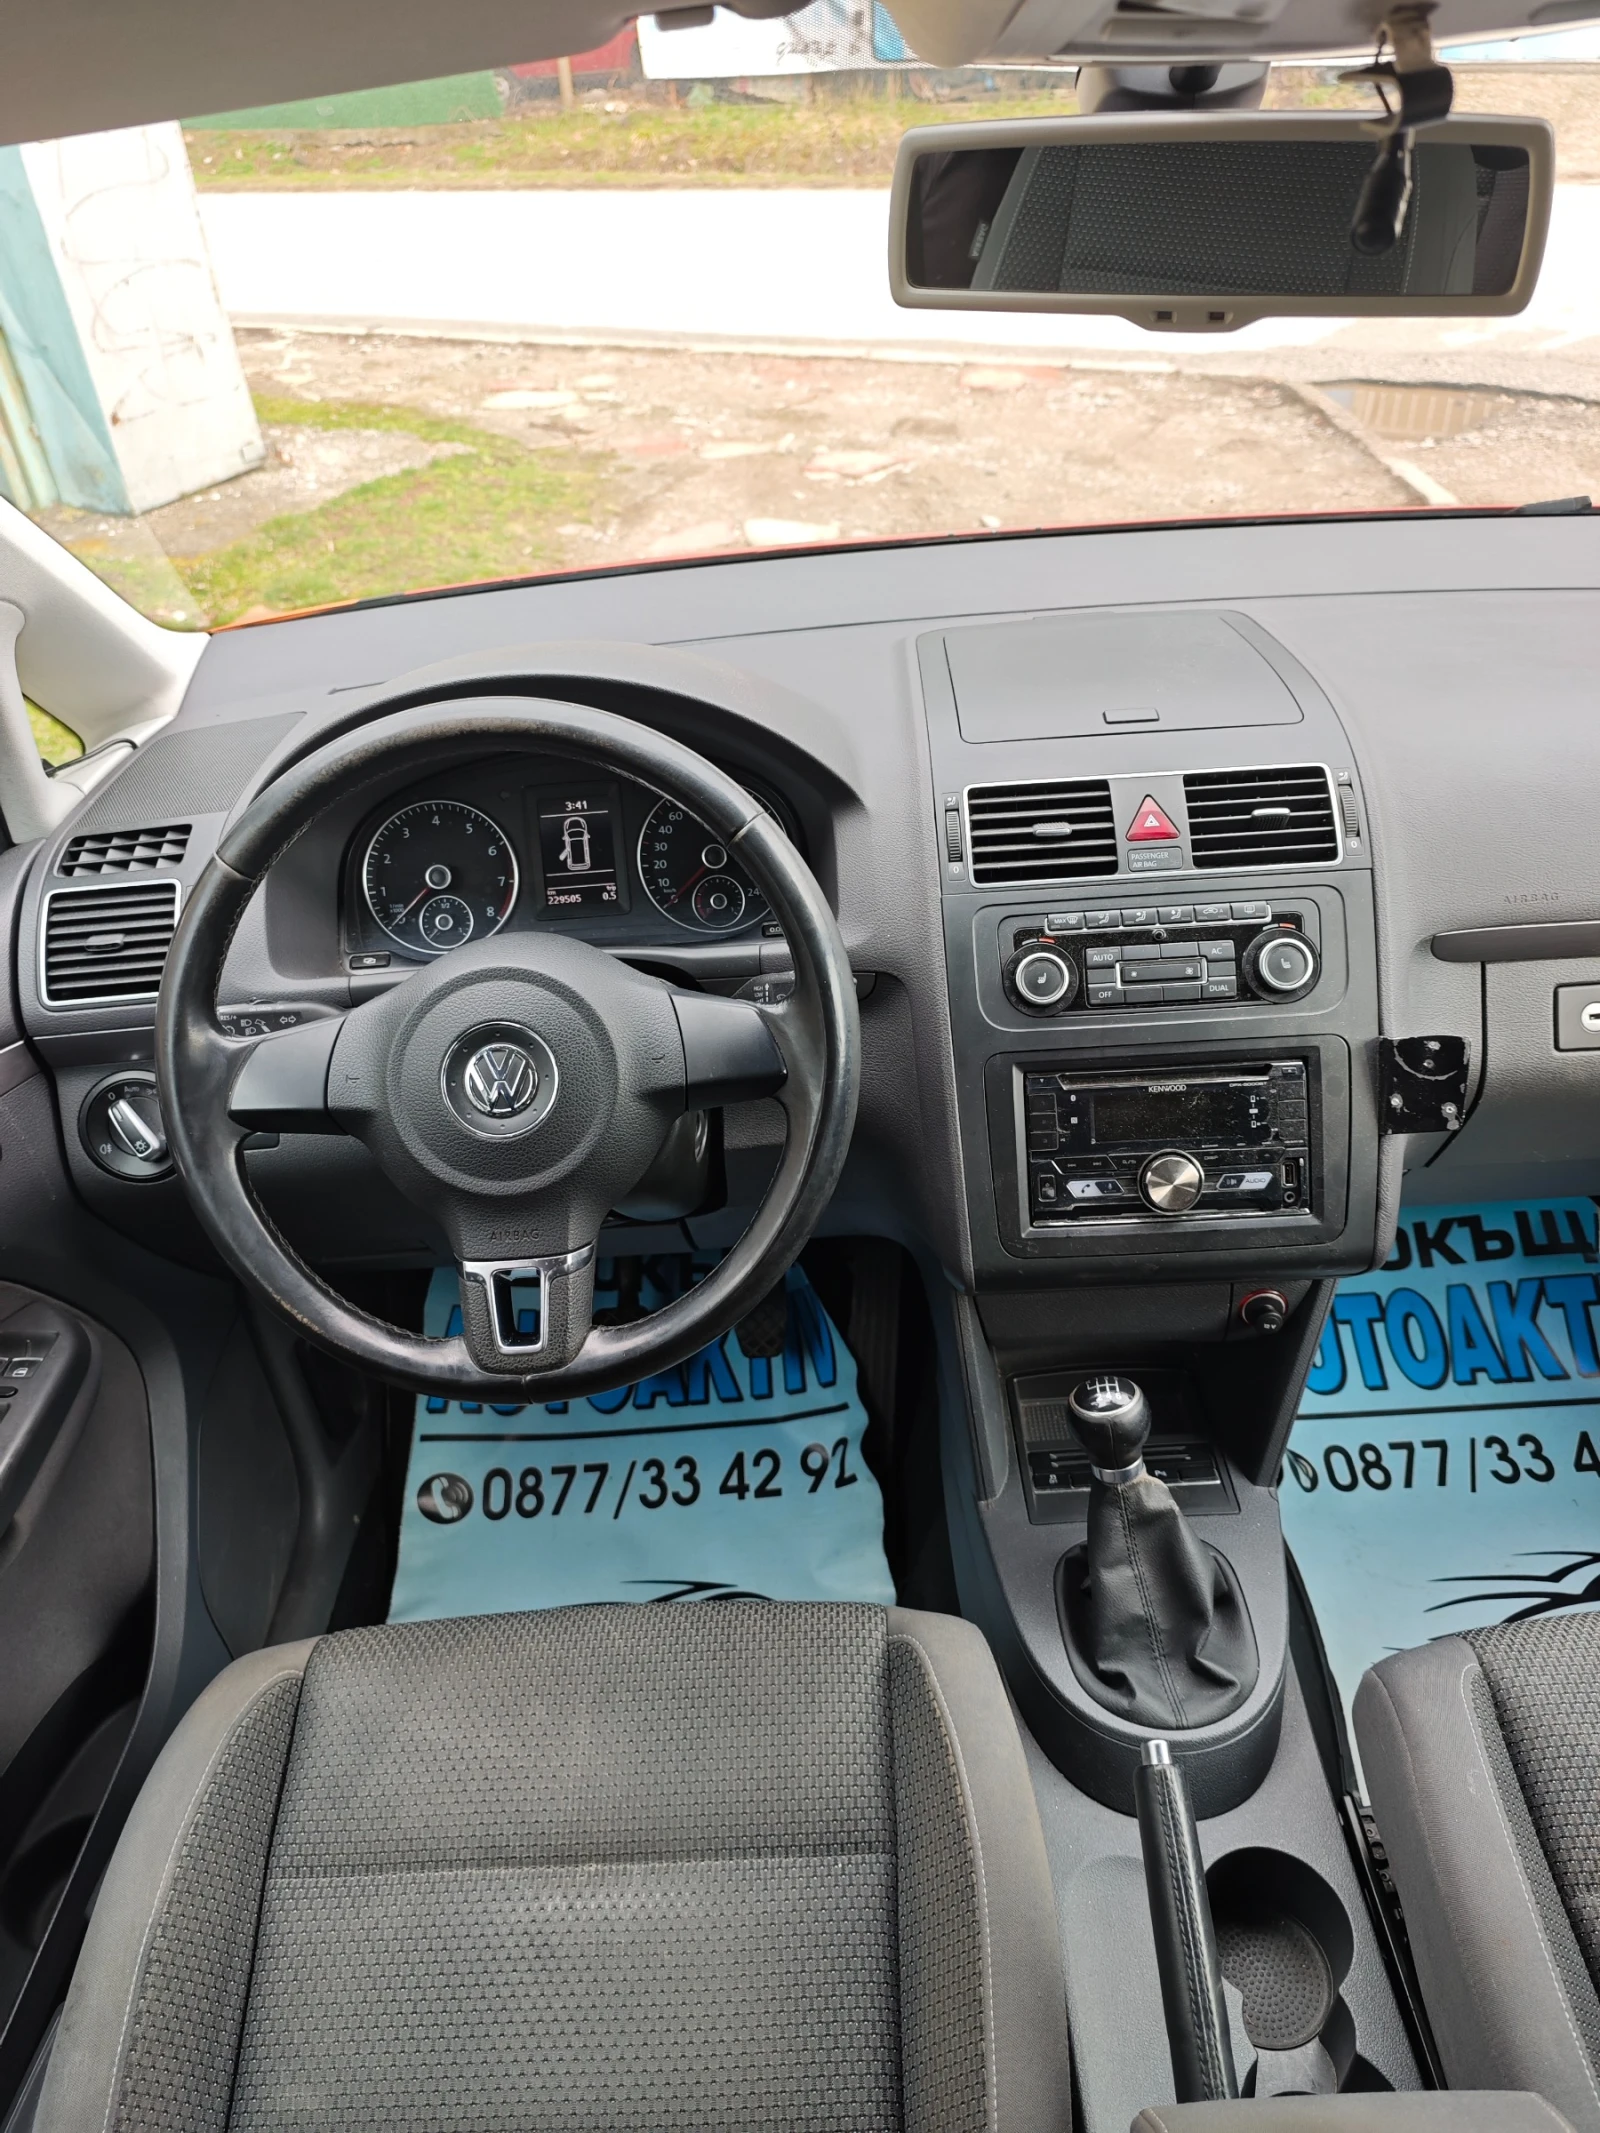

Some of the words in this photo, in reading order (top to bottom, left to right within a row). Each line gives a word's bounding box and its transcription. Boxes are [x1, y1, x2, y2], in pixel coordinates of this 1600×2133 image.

[565, 800, 588, 811] 3:41
[431, 815, 440, 826] 4
[669, 811, 683, 820] 60
[402, 828, 410, 838] 3
[465, 823, 473, 834] 5
[658, 825, 672, 834] 40
[488, 846, 497, 856] 6
[654, 842, 668, 851] 30
[383, 854, 391, 864] 2
[1131, 851, 1169, 860] PASSENGER
[653, 860, 667, 869] 20
[497, 876, 505, 887] 7
[658, 878, 670, 887] 10
[380, 887, 387, 896] 1
[602, 892, 617, 901] 0.5
[548, 894, 582, 905] 229505
[1503, 892, 1560, 905] AIRBAG
[486, 906, 495, 917] 8
[1092, 953, 1114, 962] AUTO
[1209, 984, 1229, 992] DUAL
[1148, 1083, 1187, 1093] KENWOOD
[491, 1229, 540, 1241] AIRBAG
[482, 1455, 700, 1520] 0877/33
[719, 1448, 782, 1500] 42
[799, 1437, 858, 1494] 92
